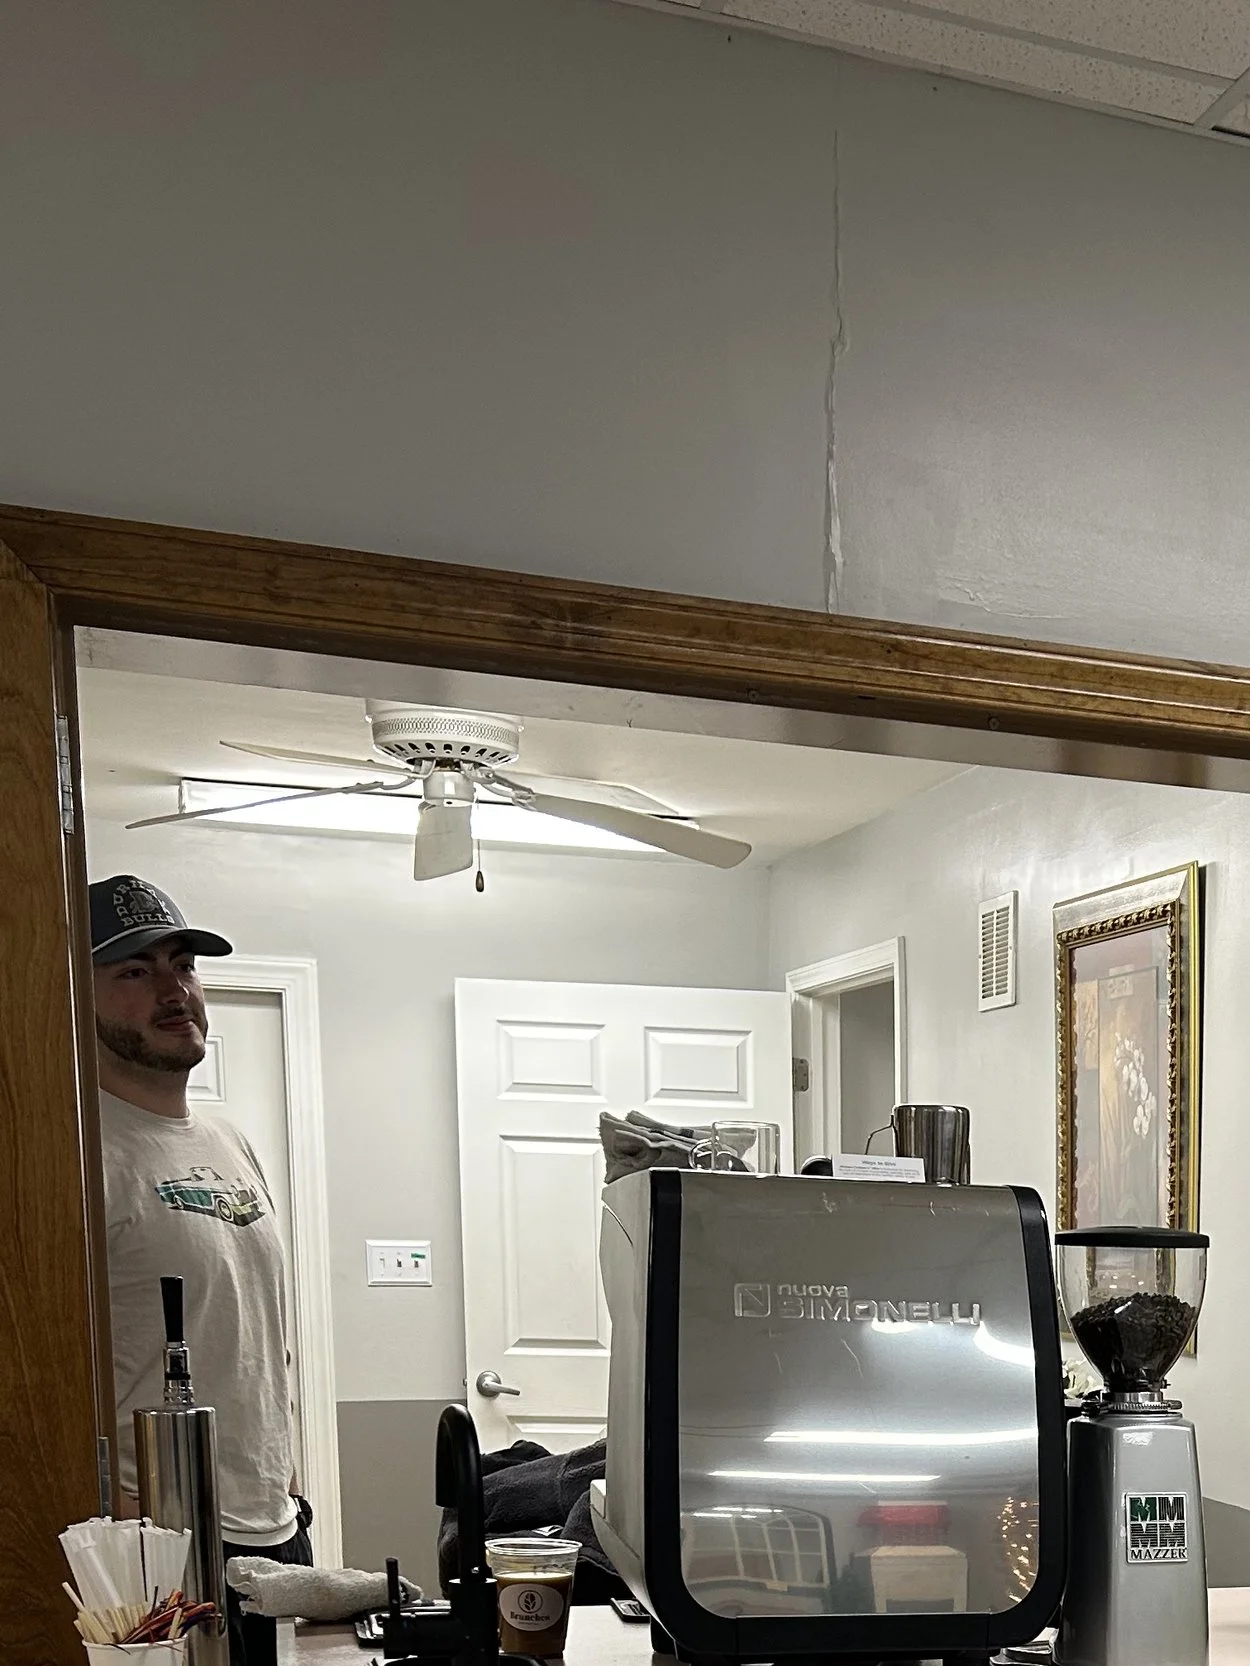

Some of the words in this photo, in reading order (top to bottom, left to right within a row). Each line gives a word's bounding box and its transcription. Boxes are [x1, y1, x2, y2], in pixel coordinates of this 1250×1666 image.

[120, 913, 175, 927] BULLS
[777, 1283, 849, 1298] nuova
[778, 1298, 982, 1326] SIMONELLI
[1131, 1548, 1187, 1559] MAZZER
